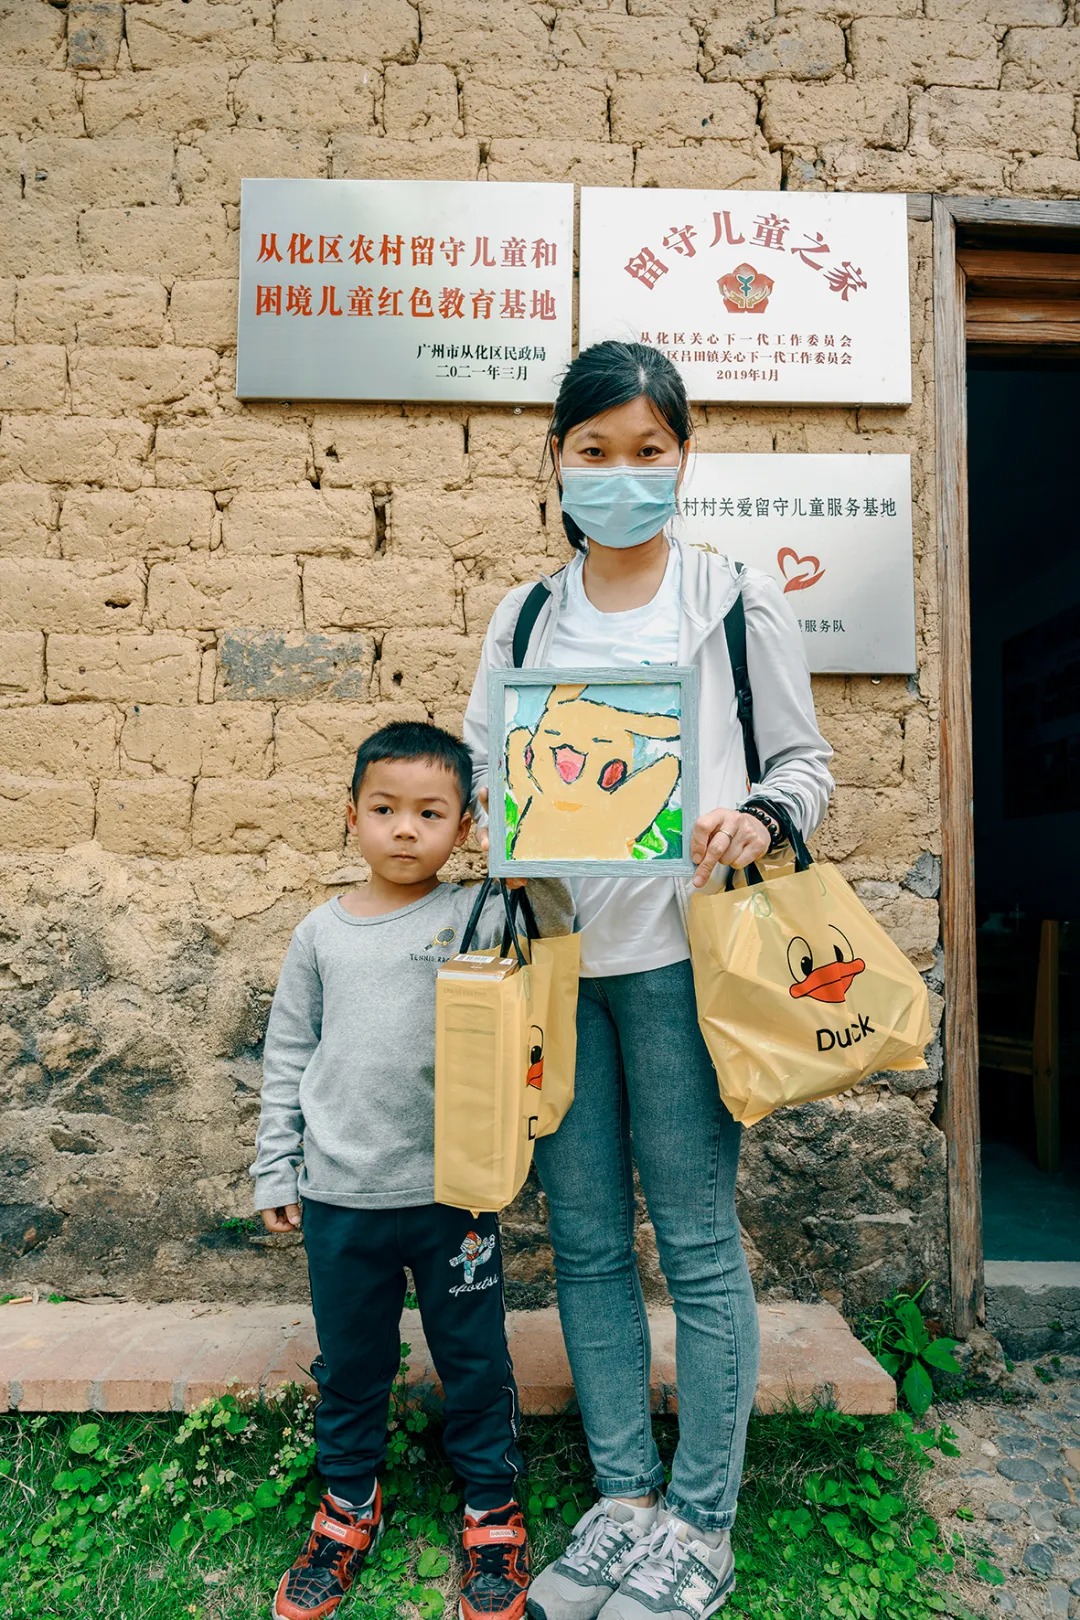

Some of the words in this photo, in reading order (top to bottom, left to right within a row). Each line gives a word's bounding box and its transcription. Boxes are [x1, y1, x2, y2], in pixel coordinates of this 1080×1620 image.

[256, 233, 557, 268] 从化区农村留守儿童和
[623, 210, 868, 302] 留守儿童之家
[256, 284, 557, 321] 困境儿童红色教育基地
[641, 331, 853, 347] 从化区关心下一代工作委员会
[416, 344, 546, 361] 广州市从化区民政局
[662, 350, 853, 365] 区吕田镇关心下一代工作委员会
[717, 368, 779, 382] 2019年1月
[677, 496, 897, 518] 村村关爱留守儿童服务基地
[410, 953, 435, 962] TENNIS
[816, 1013, 875, 1051] Duck
